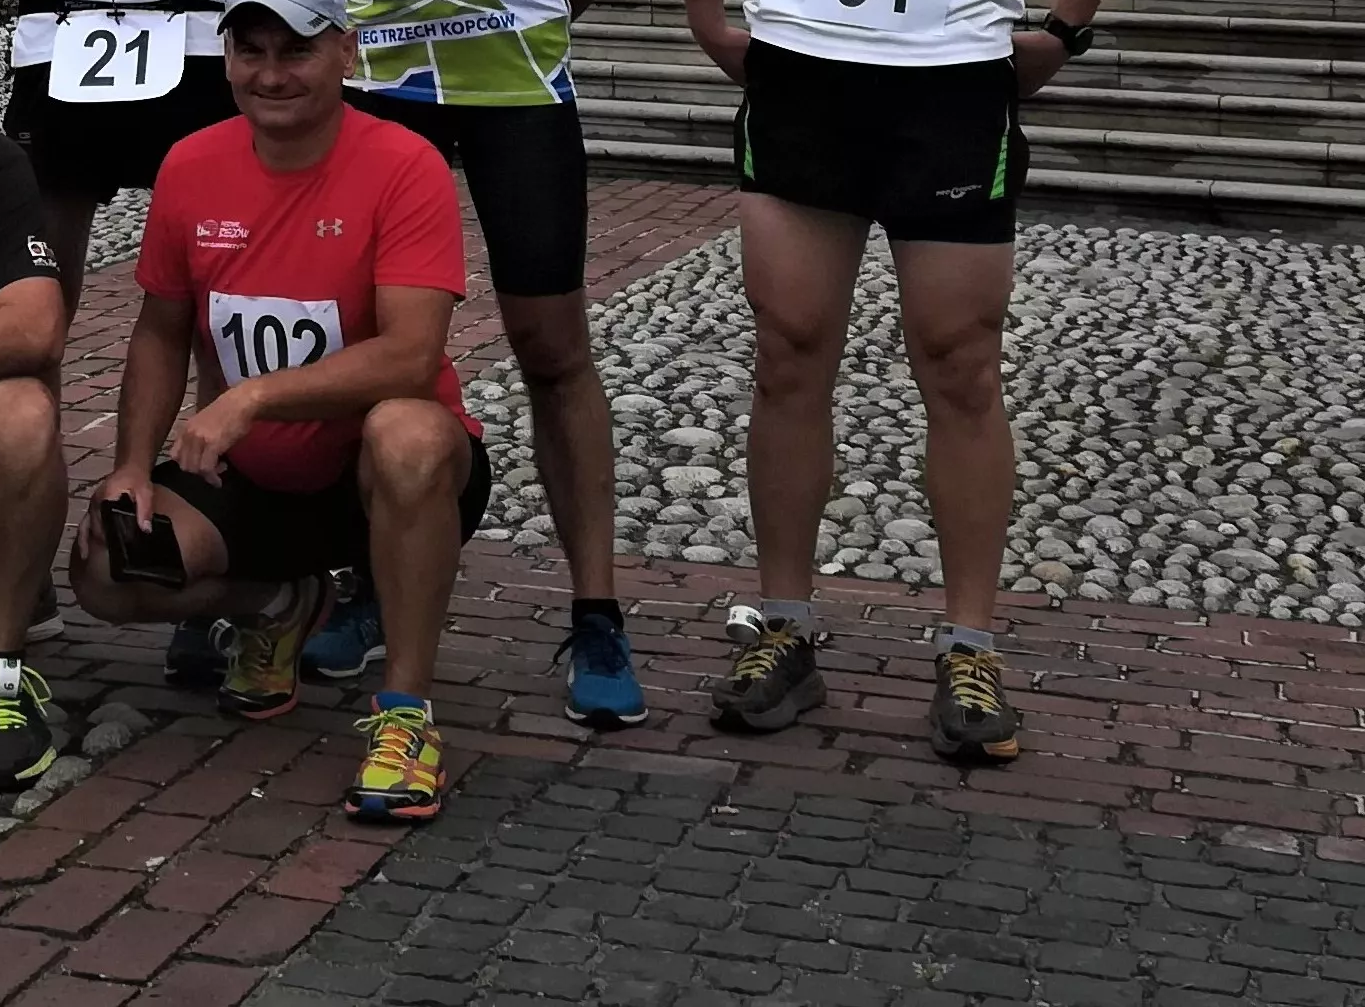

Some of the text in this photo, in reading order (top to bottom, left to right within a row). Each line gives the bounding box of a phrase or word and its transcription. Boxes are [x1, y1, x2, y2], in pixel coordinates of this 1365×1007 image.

[79, 29, 150, 87] 21
[359, 13, 515, 45] IEG TRZECH KOPCÓW
[222, 312, 327, 379] 102
